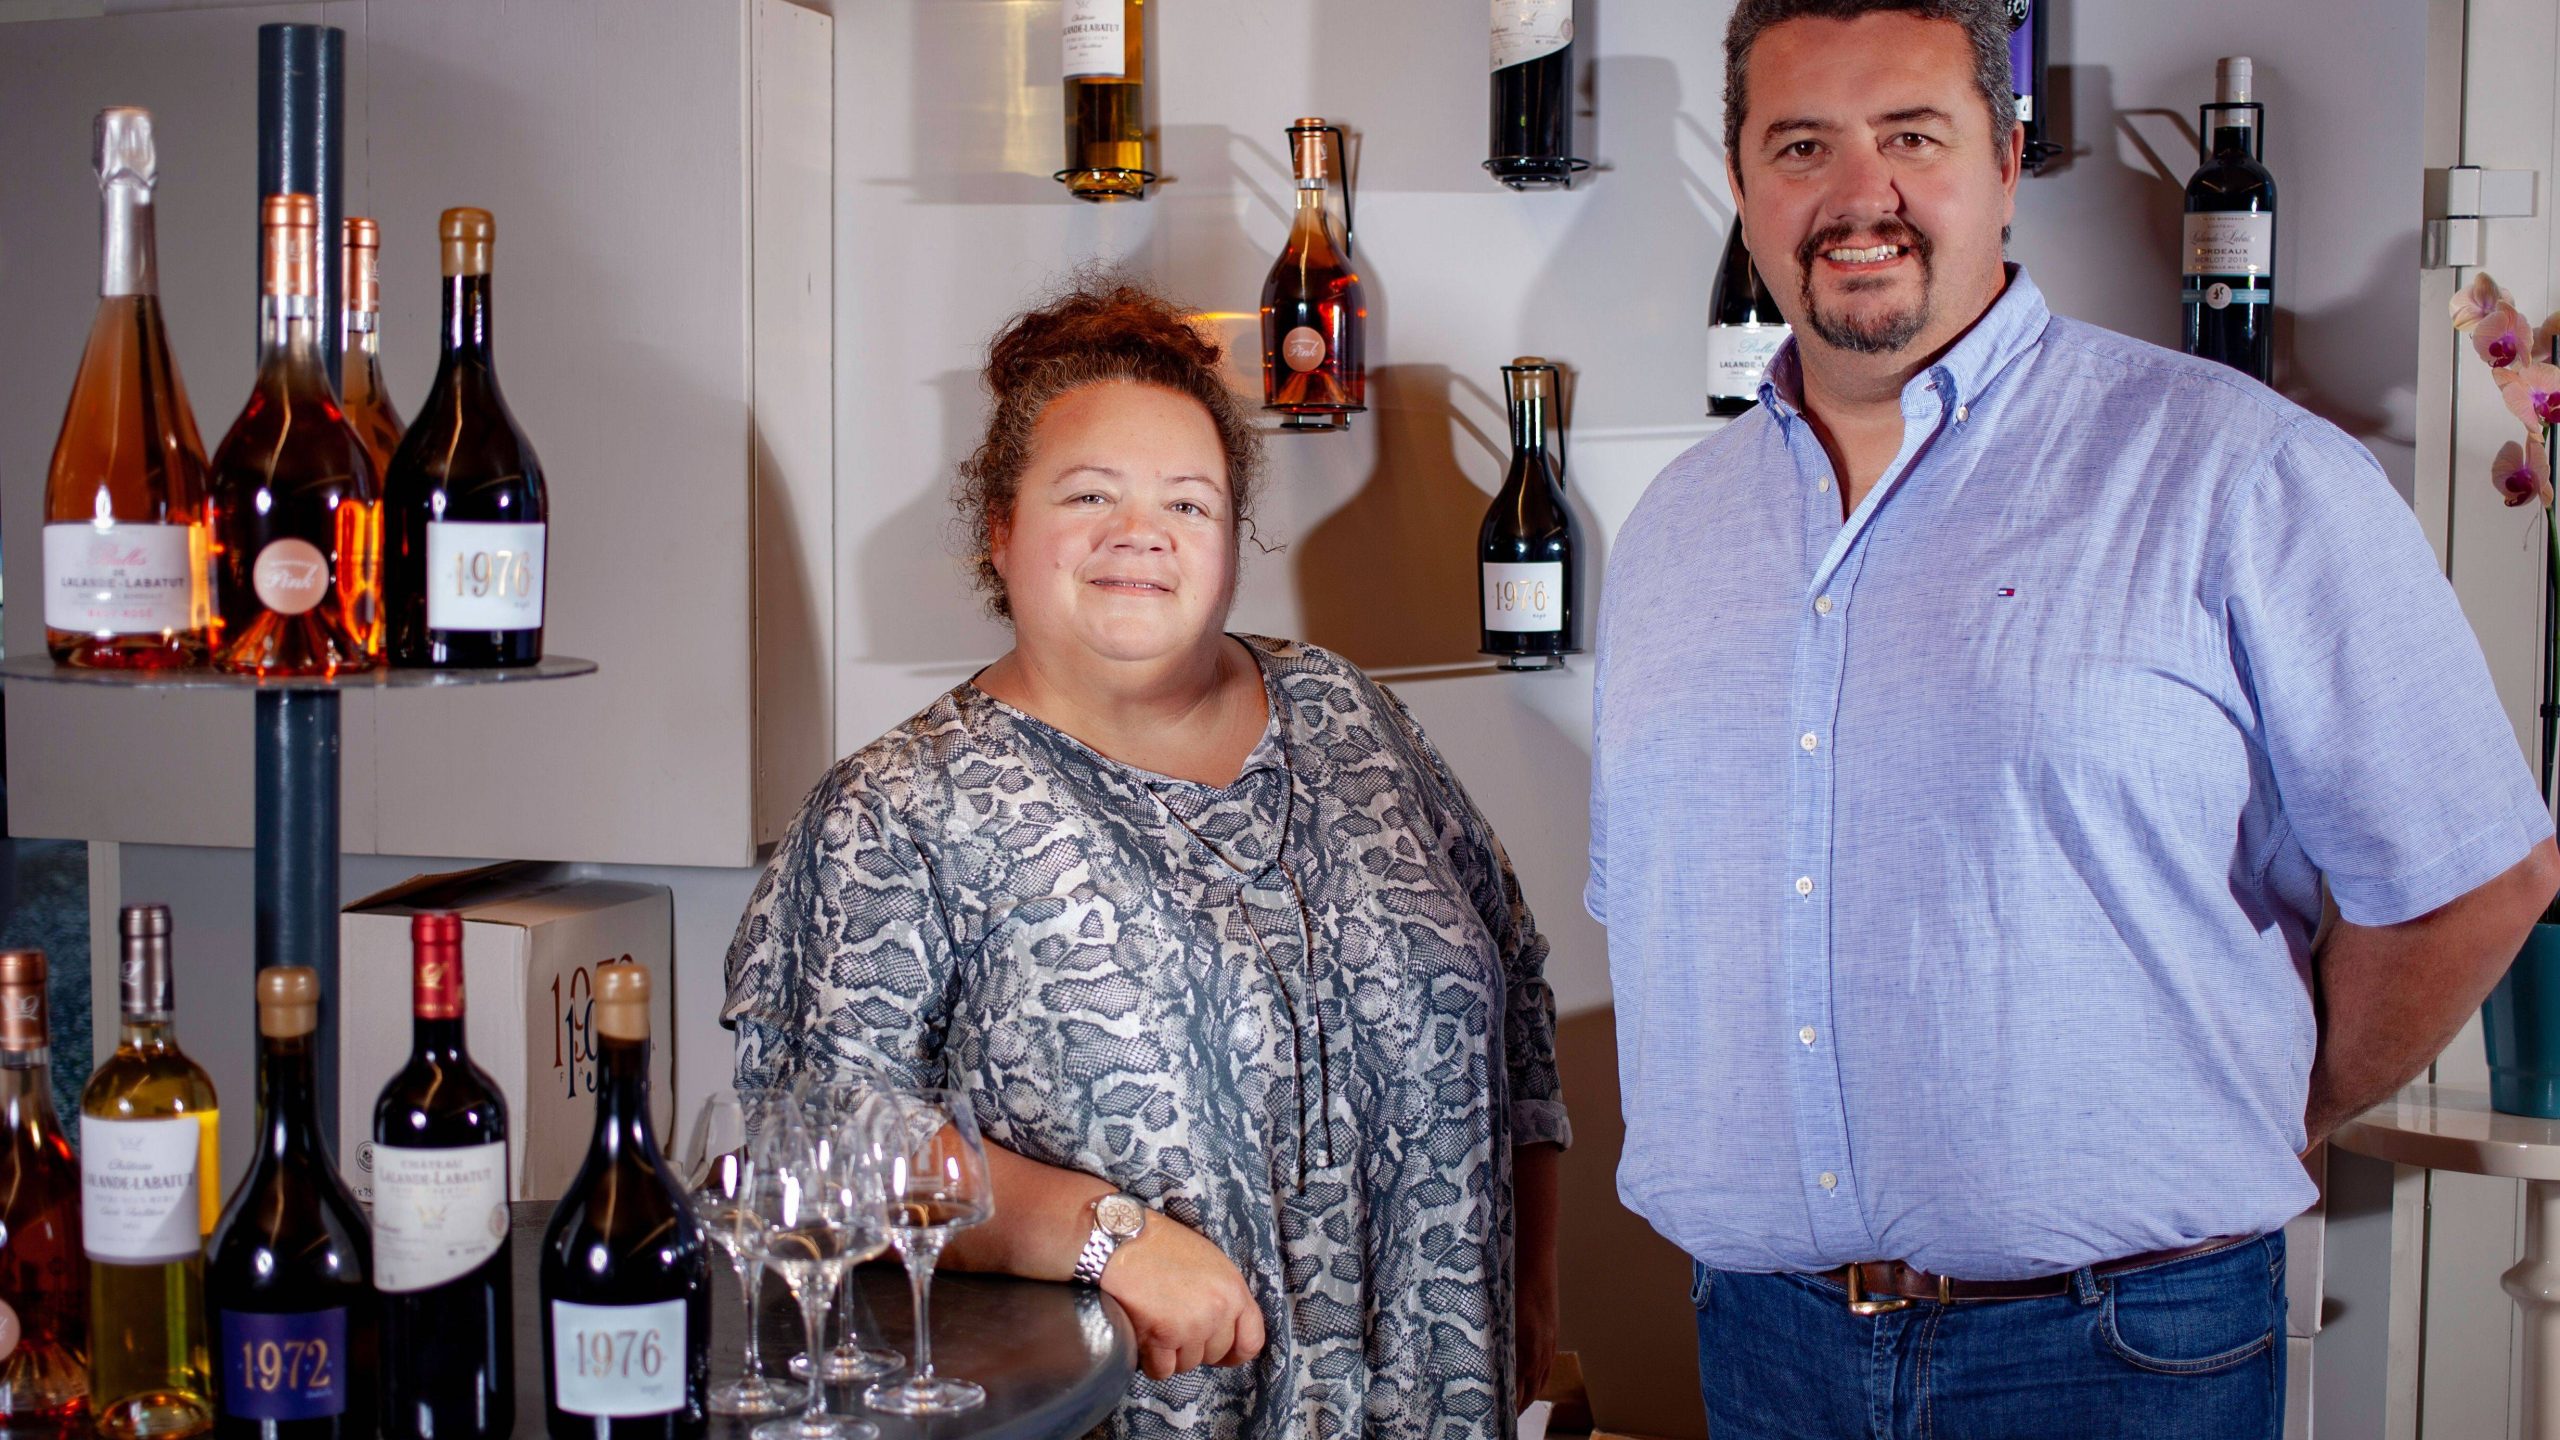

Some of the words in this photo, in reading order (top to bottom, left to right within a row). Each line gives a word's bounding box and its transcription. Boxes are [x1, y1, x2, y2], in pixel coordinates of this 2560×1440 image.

[2196, 248, 2249, 256] ORDEAUX
[452, 550, 532, 598] 1976
[1495, 580, 1547, 612] 1976
[243, 1338, 332, 1392] 1972
[576, 1328, 663, 1379] 1976
